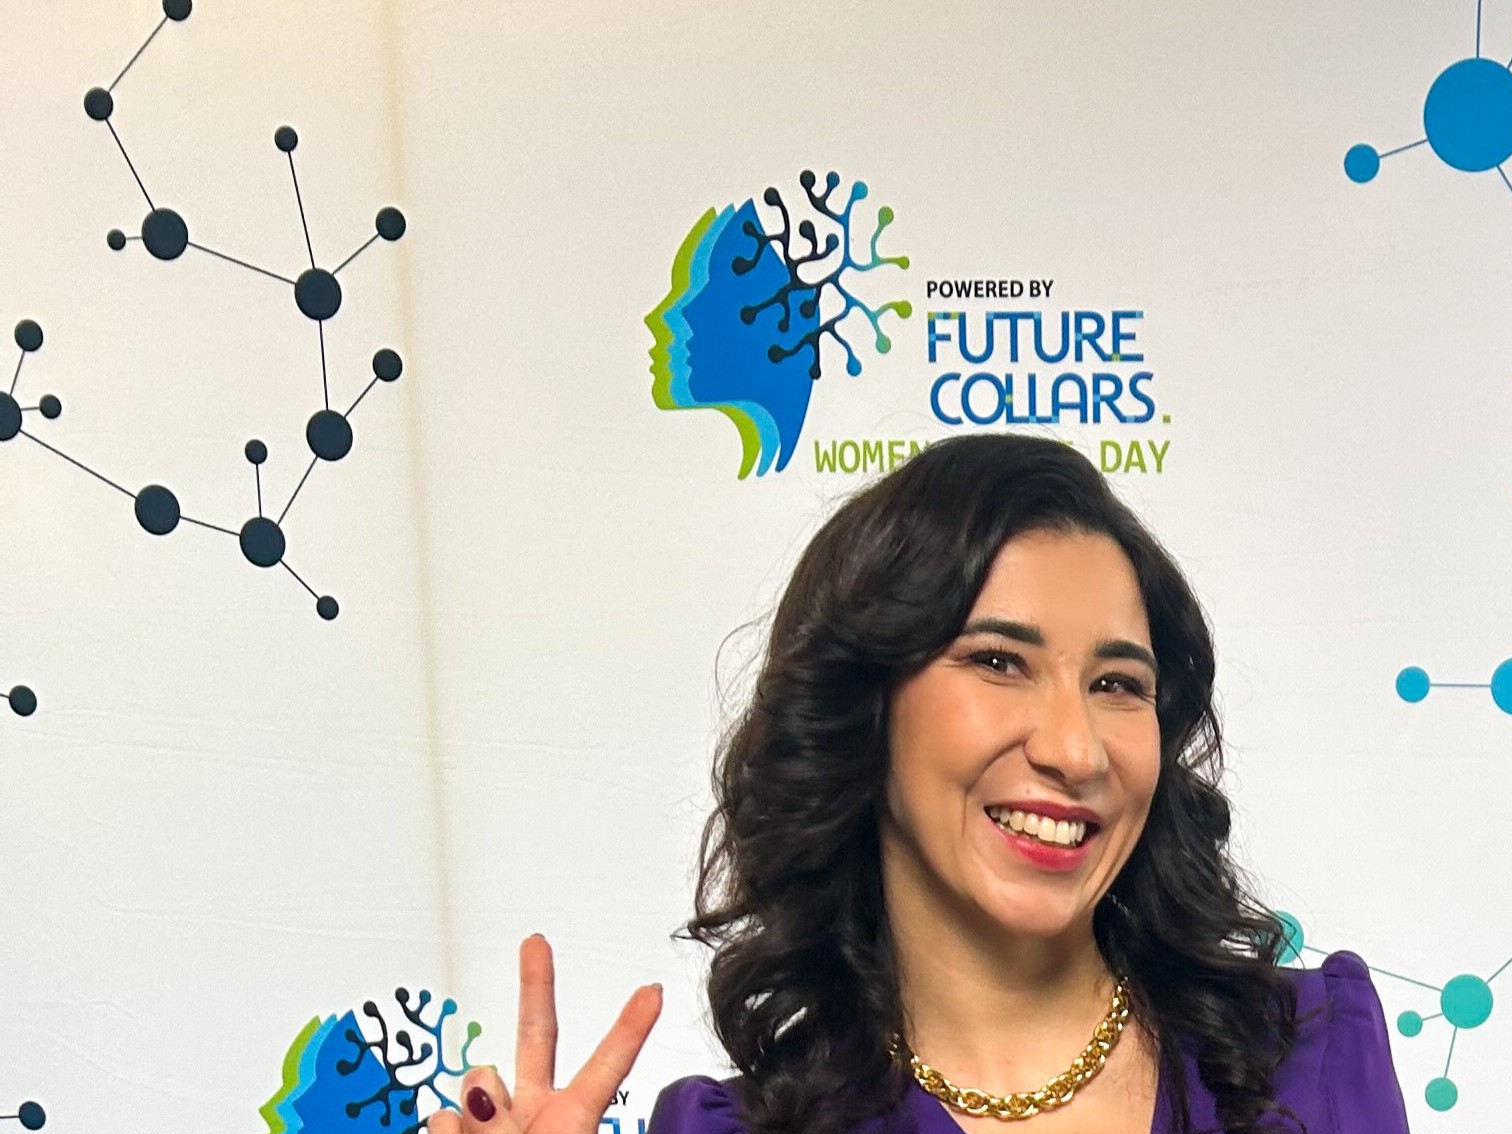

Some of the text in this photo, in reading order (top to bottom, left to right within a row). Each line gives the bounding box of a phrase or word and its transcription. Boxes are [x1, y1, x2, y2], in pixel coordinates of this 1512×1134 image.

[926, 279, 1054, 298] POWERED BY
[927, 310, 1145, 364] FUTURE
[1099, 439, 1172, 473] DAY
